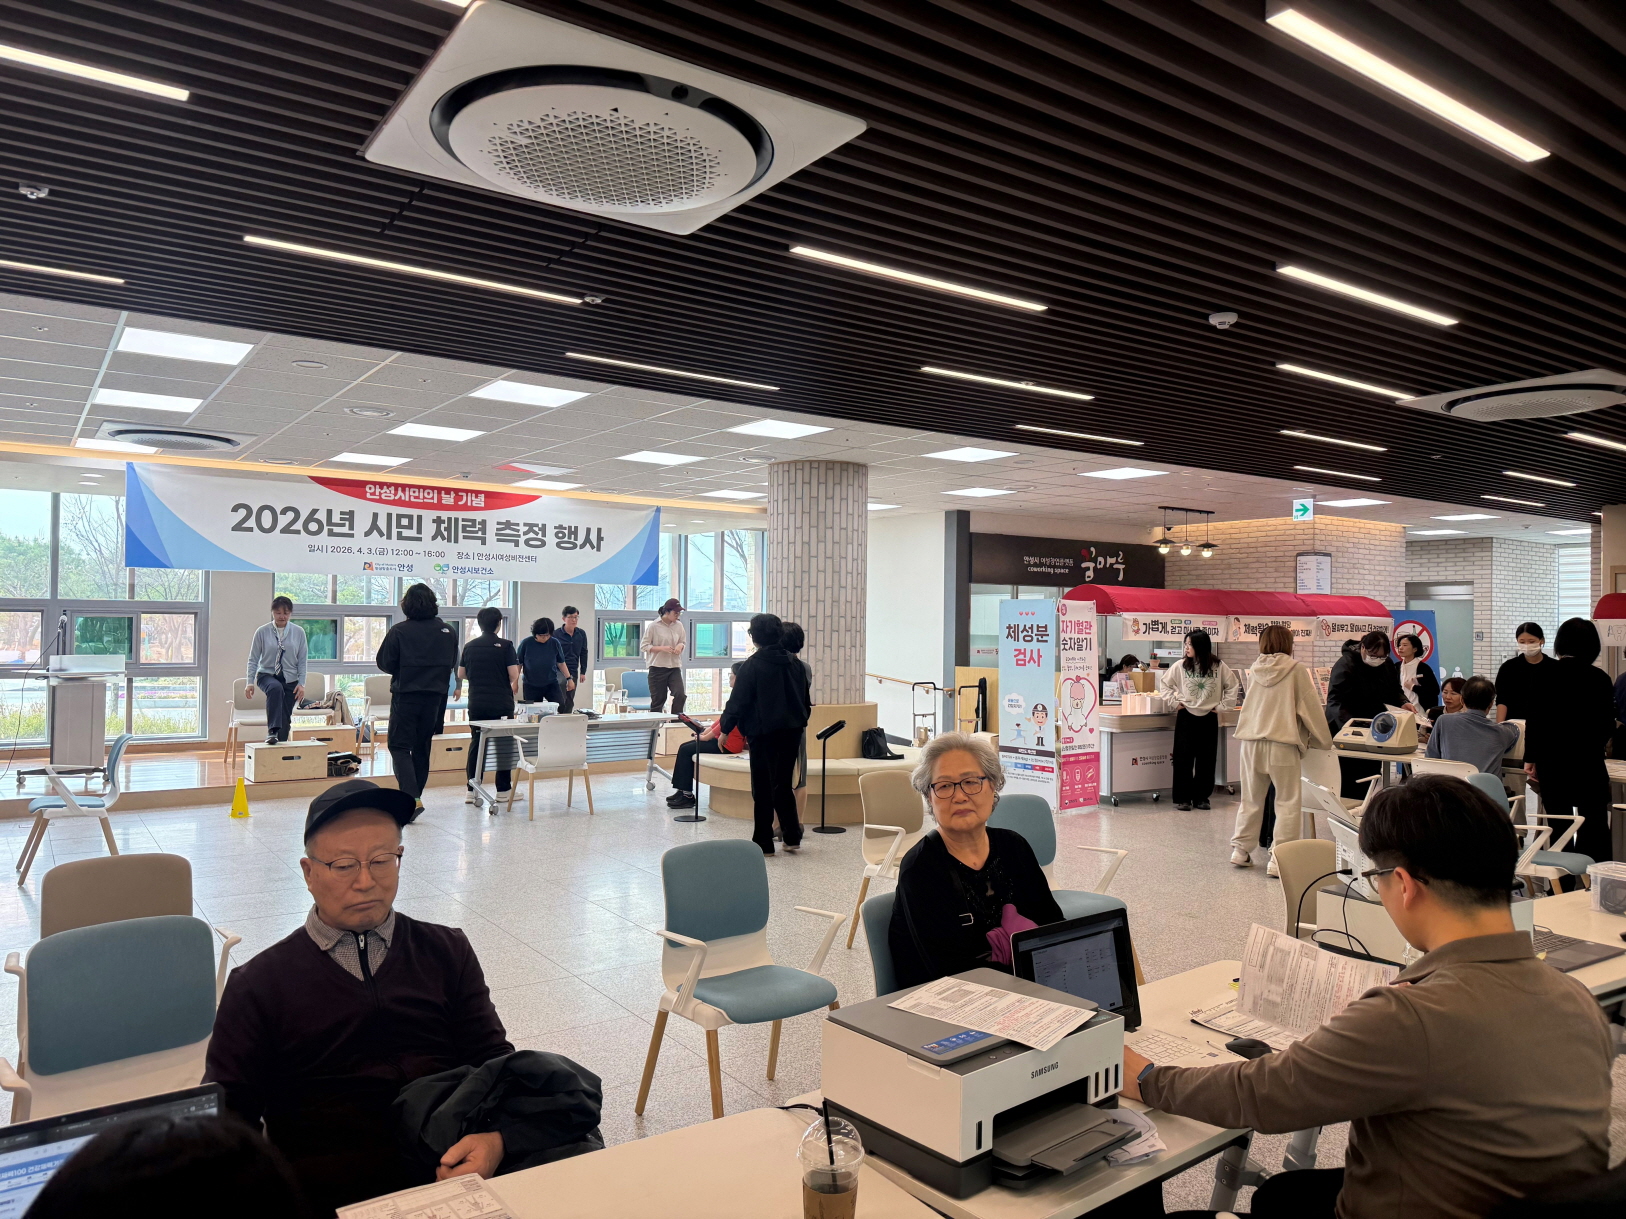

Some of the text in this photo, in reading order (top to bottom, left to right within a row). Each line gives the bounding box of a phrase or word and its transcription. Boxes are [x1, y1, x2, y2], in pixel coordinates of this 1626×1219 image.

[365, 484, 485, 507] 안성시민의 날 기념
[230, 502, 605, 552] 2026년 시민 체력 측정 행사
[307, 544, 324, 554] 일시
[330, 545, 355, 555] 2026.
[391, 548, 414, 556] 12:00
[423, 550, 446, 558] 16:00
[456, 551, 471, 560] 장소
[476, 552, 537, 563] 안성시여성비전센터
[397, 563, 414, 572] 안성
[451, 565, 495, 575] 안성시보건소
[1027, 565, 1054, 574] coworking
[1005, 623, 1050, 643] 체성분
[1061, 619, 1093, 635] 자기혈관
[1142, 619, 1170, 635] 가볍게,
[1061, 637, 1092, 651] 숫자알기
[1013, 648, 1043, 668] 검사
[1030, 1061, 1059, 1079] SAMSUNG
